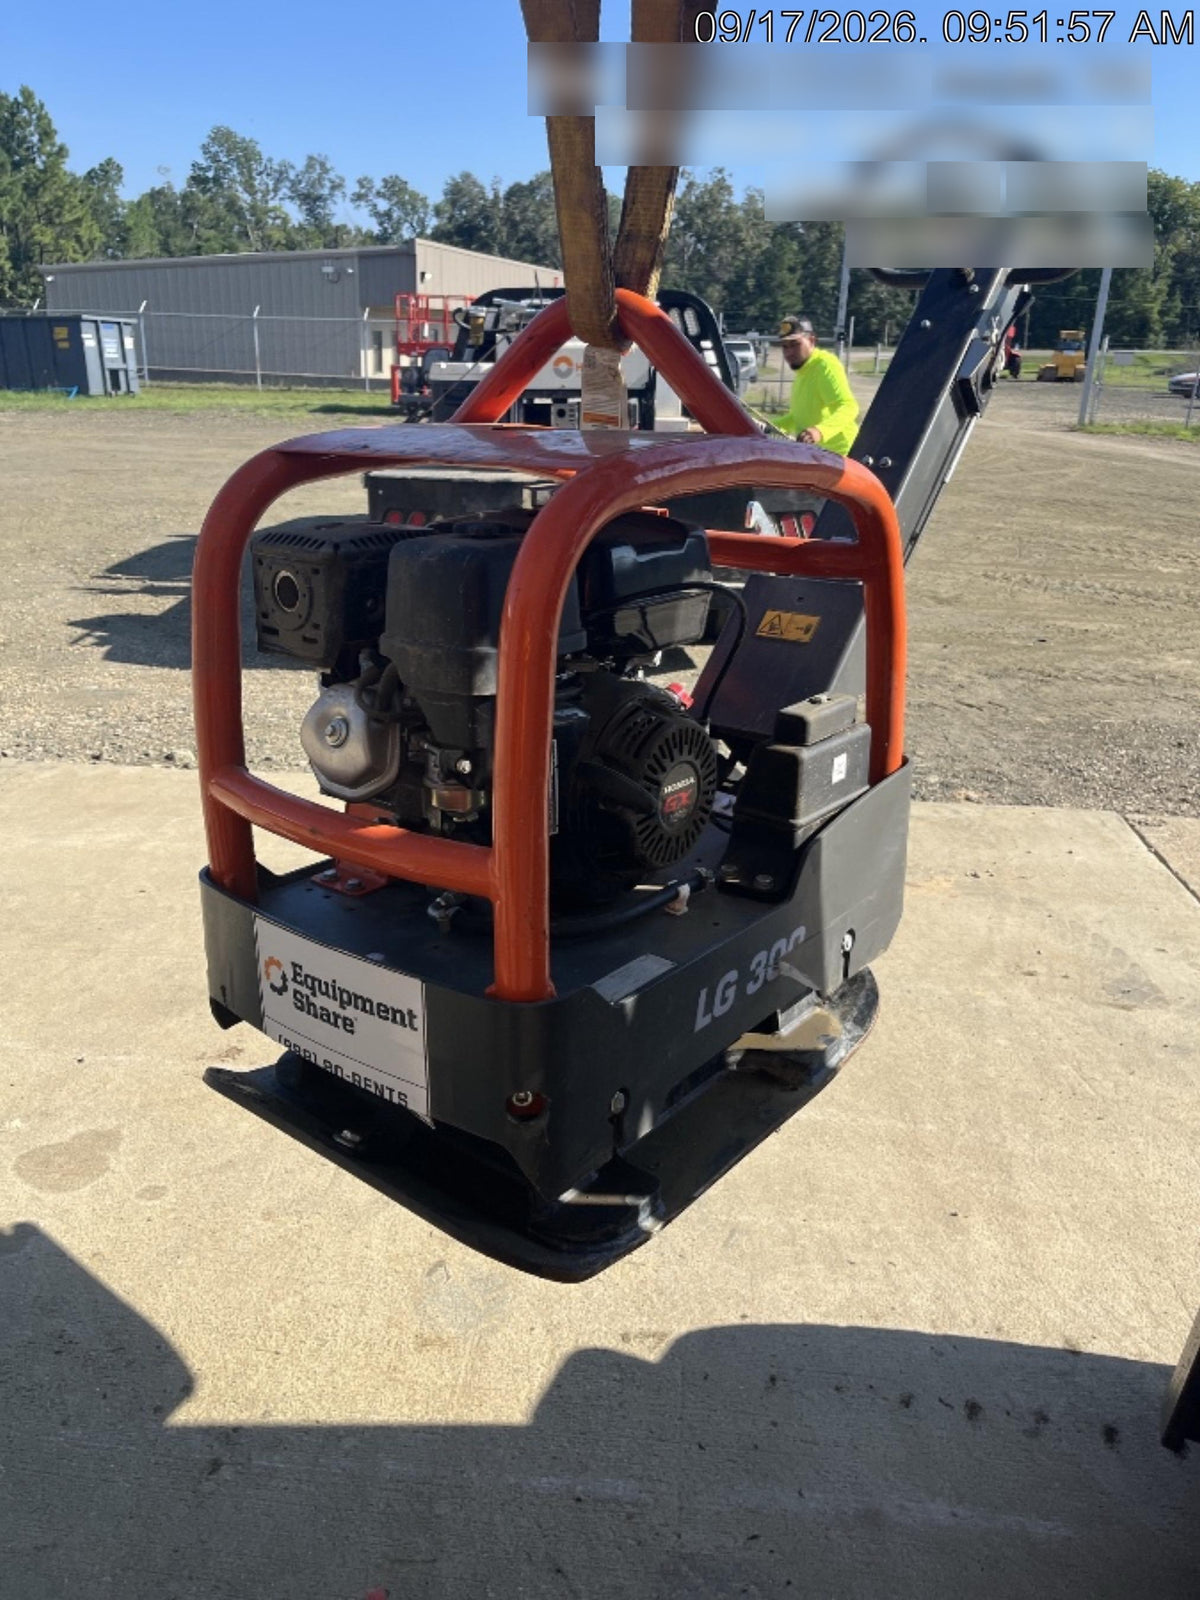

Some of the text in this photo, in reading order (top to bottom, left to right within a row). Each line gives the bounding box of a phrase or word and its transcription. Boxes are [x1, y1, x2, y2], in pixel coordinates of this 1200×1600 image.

[290, 961, 418, 1032] Equipment
[292, 988, 355, 1035] Share
[693, 969, 739, 1033] LG
